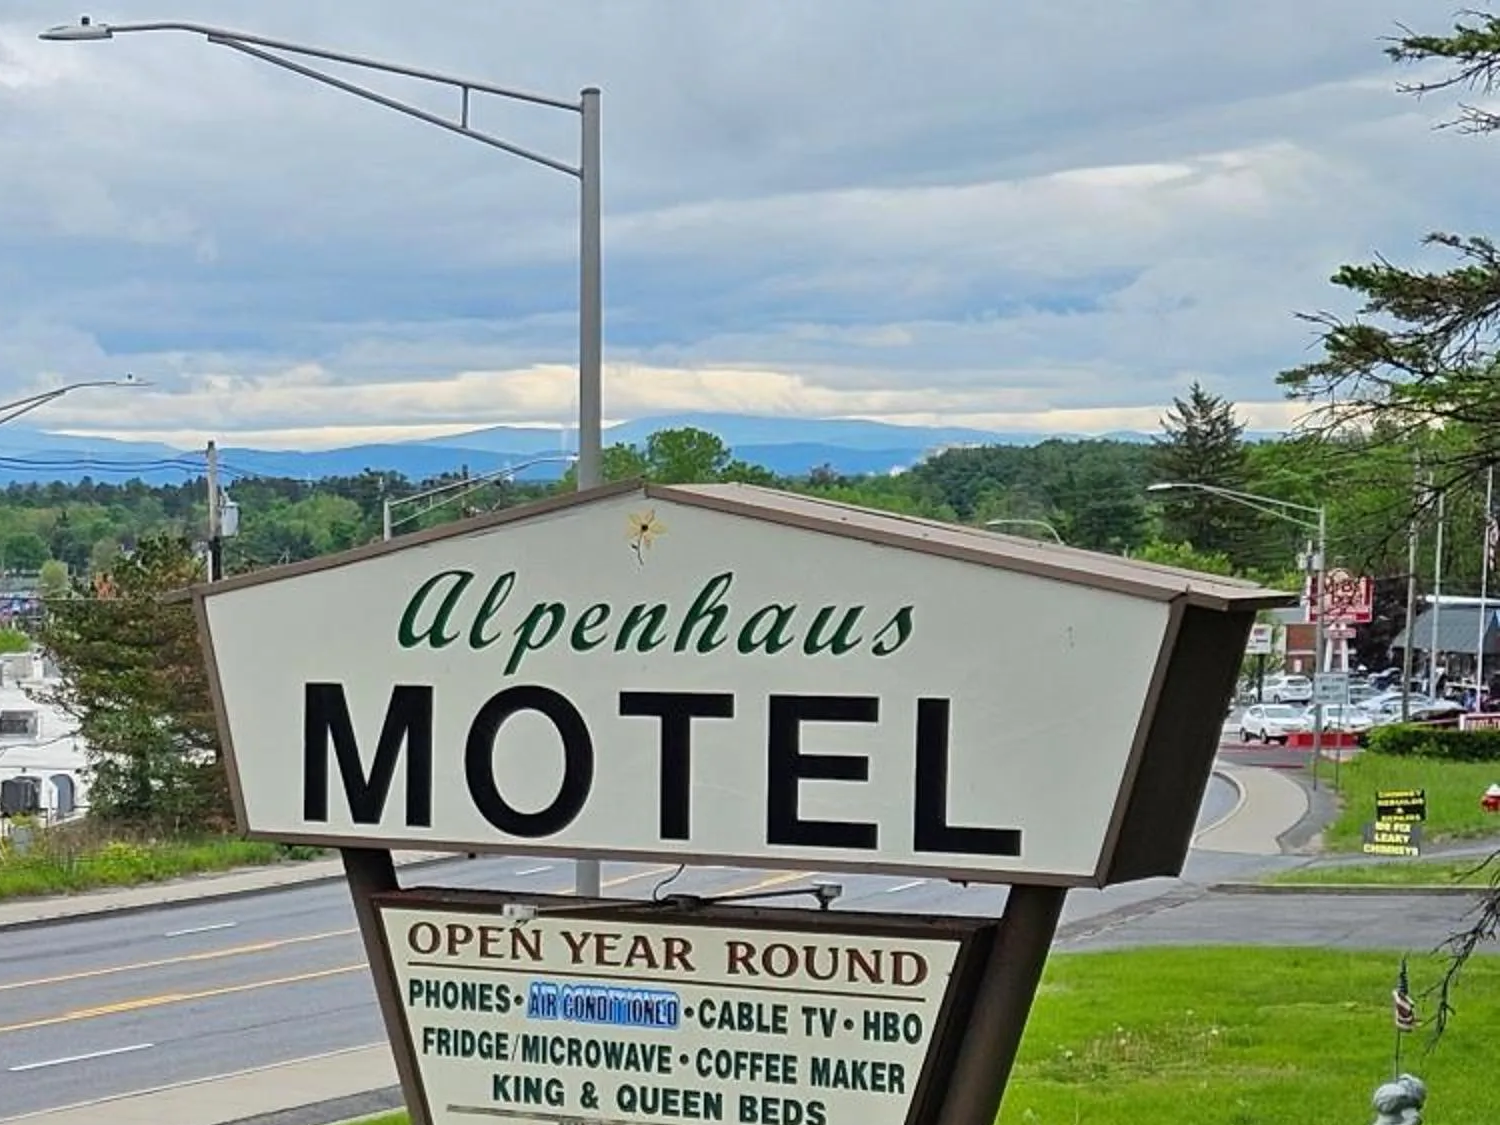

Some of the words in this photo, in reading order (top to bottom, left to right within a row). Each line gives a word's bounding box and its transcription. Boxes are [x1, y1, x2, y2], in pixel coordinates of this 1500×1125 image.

[397, 569, 913, 675] Alpenhaus
[301, 681, 1022, 857] MOTEL
[408, 921, 543, 961] OPEN
[560, 931, 695, 971] YEAR
[725, 941, 928, 986] ROUND
[409, 978, 510, 1013] PHONES
[529, 982, 557, 1018] AIR
[563, 985, 680, 1027] CONDITIONED
[699, 998, 788, 1034] CABLE
[802, 1006, 837, 1037] TV
[863, 1010, 922, 1044] HBO
[493, 1074, 565, 1107] KING
[581, 1081, 599, 1109] &
[616, 1085, 723, 1121] QUEEN
[696, 1048, 797, 1084] COFFEE
[811, 1056, 905, 1094] MAKER
